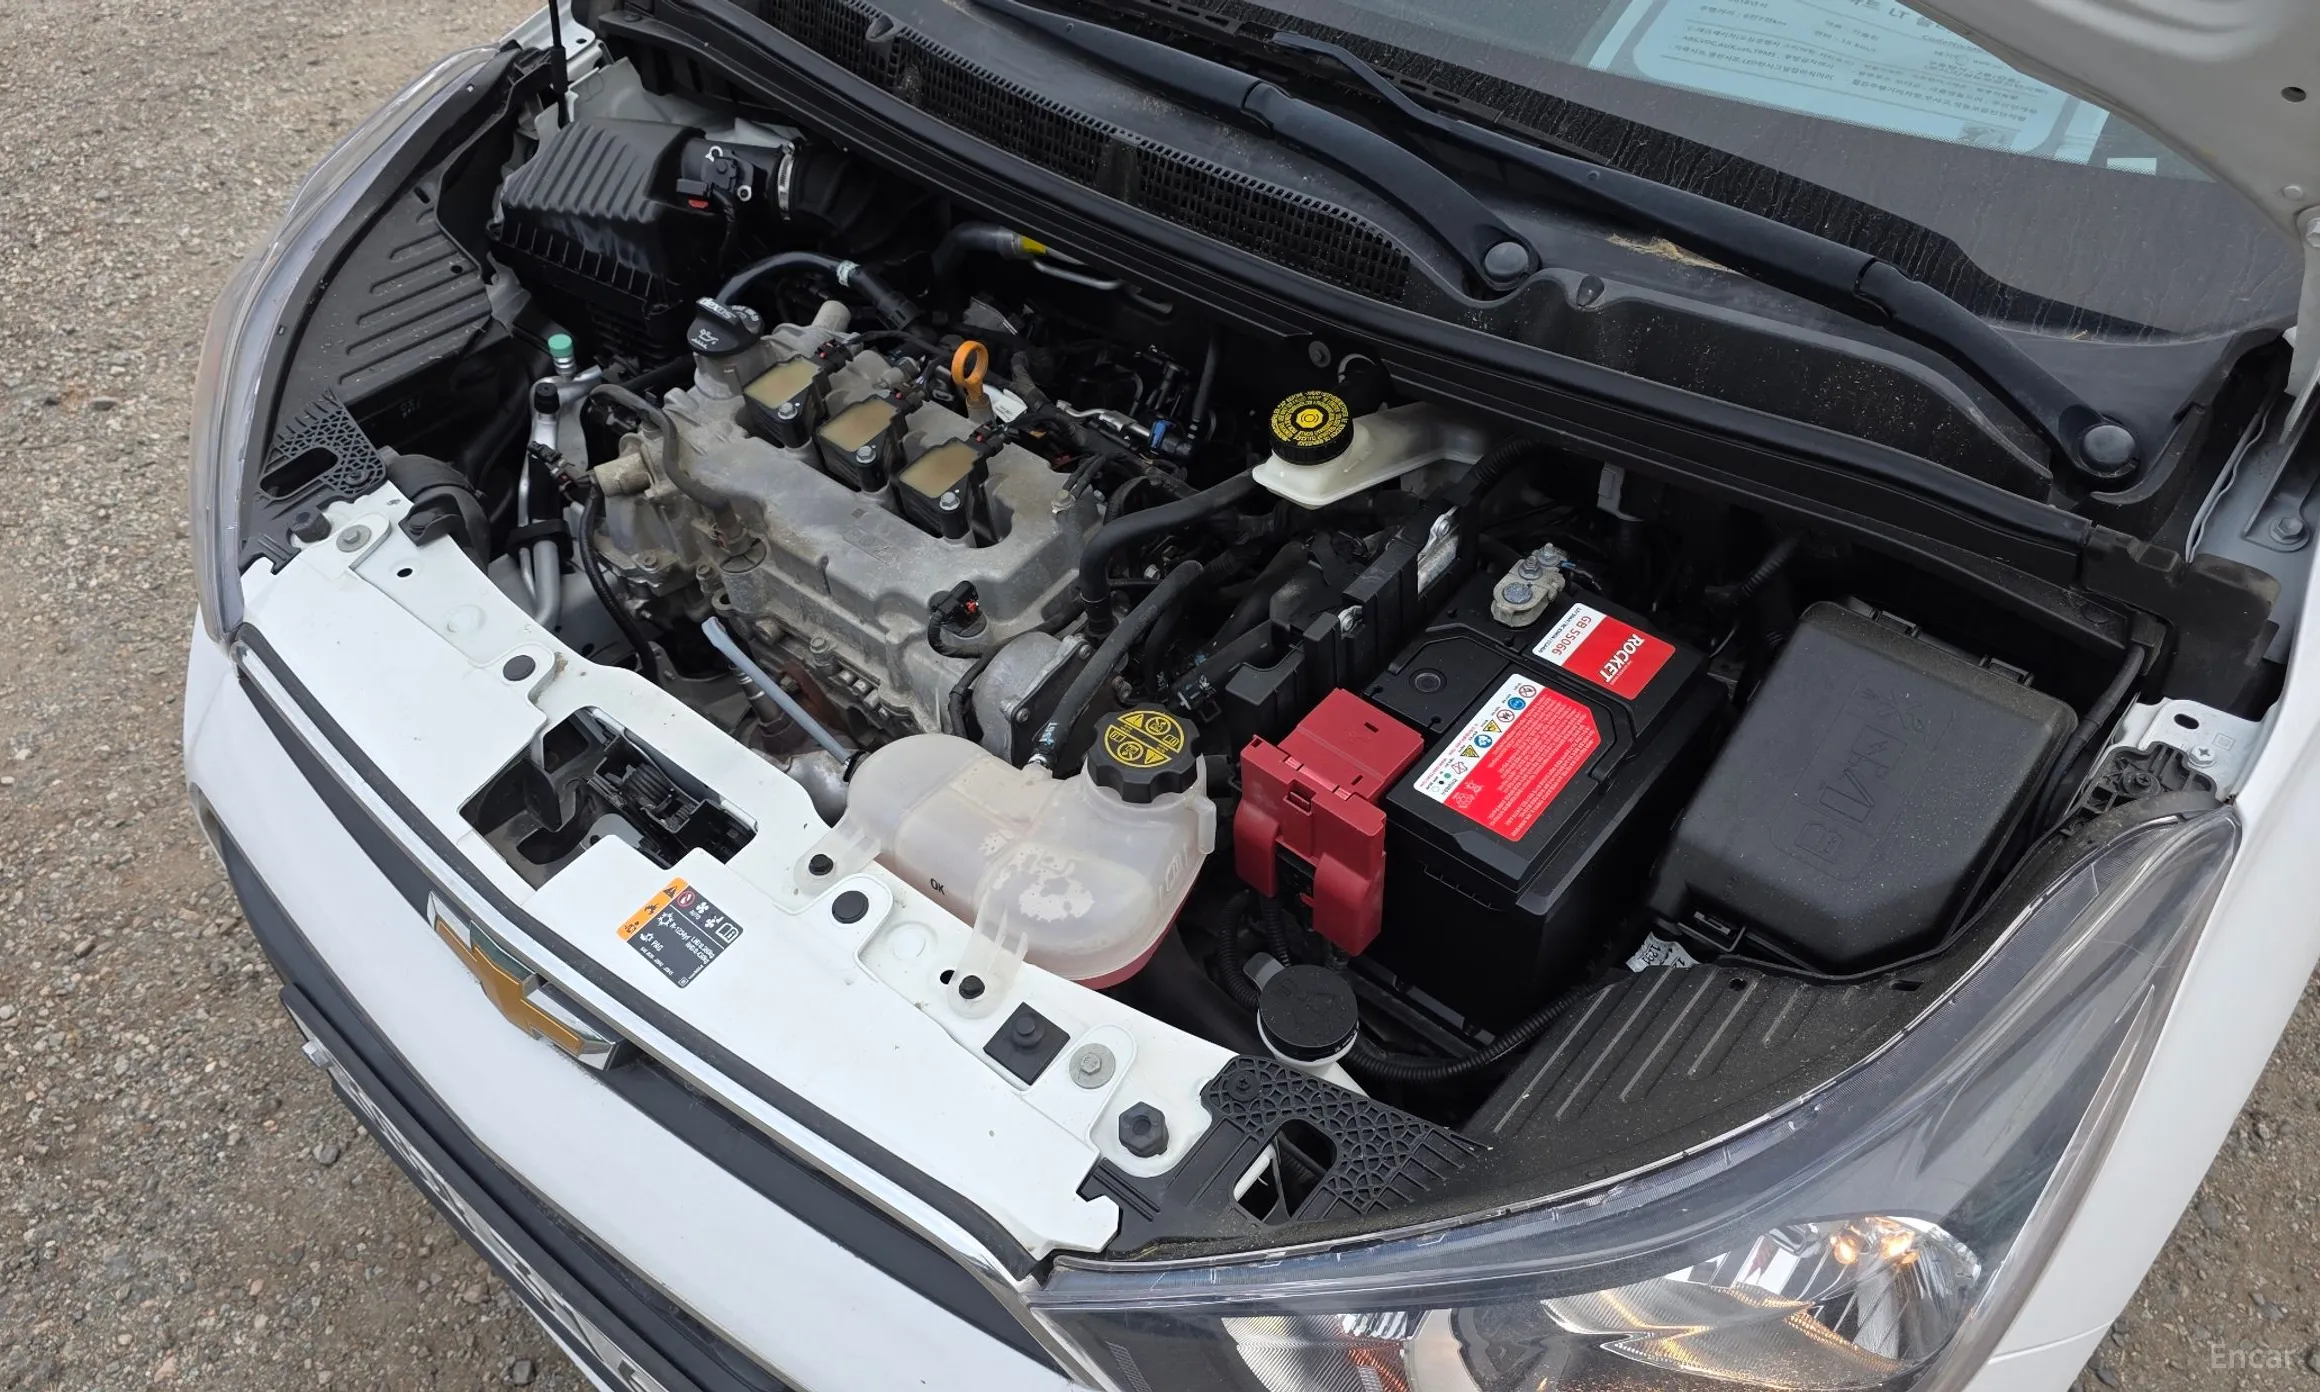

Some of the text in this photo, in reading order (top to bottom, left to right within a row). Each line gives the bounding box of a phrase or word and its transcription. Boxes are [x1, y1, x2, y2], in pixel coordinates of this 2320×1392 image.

[1575, 615, 1592, 629] GB
[1551, 627, 1581, 657] 55066
[1598, 633, 1646, 684] ROCKET
[930, 877, 946, 896] OK
